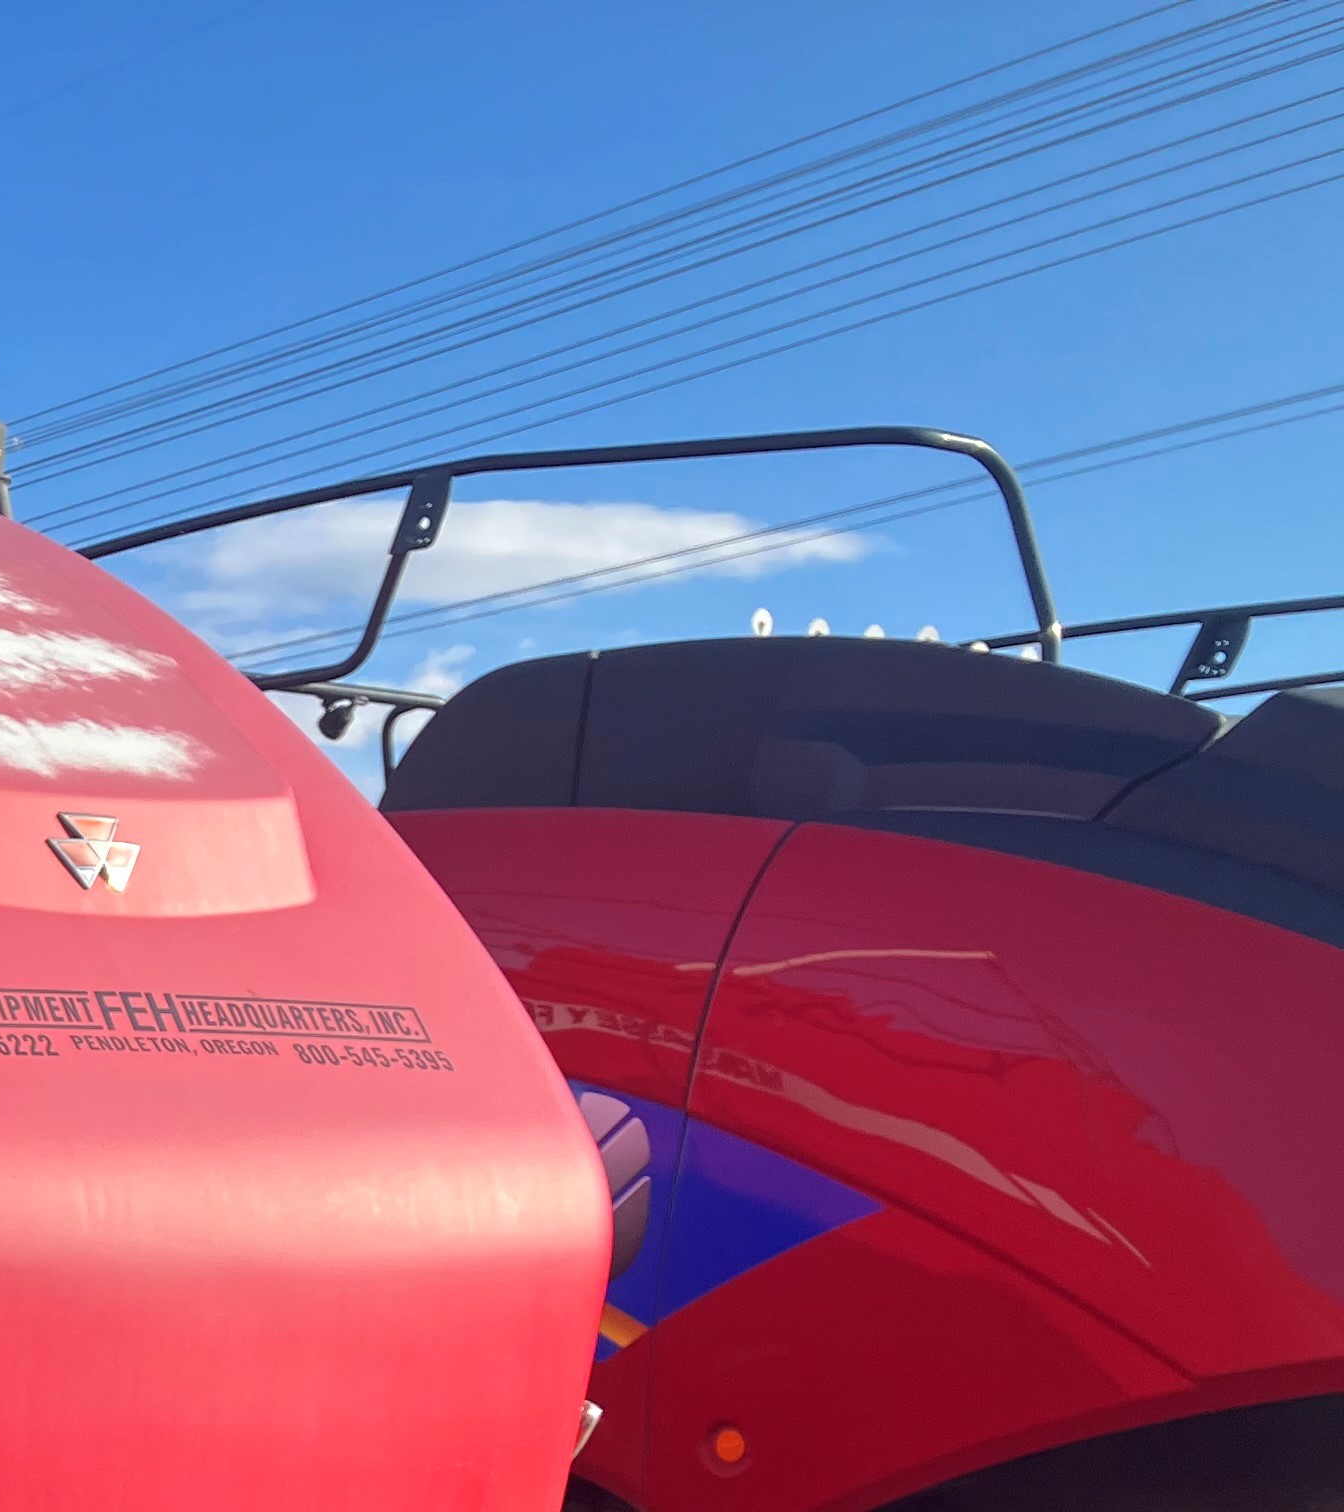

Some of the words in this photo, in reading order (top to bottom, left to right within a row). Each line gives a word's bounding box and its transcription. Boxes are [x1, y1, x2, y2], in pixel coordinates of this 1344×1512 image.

[93, 990, 186, 1033] FEH
[179, 1000, 371, 1035] HEADQUARTERS,
[368, 1009, 421, 1037] INC.
[68, 1034, 199, 1056] PENDLETON,
[199, 1038, 280, 1057] OREGON
[292, 1043, 455, 1072] 800-545-5395
